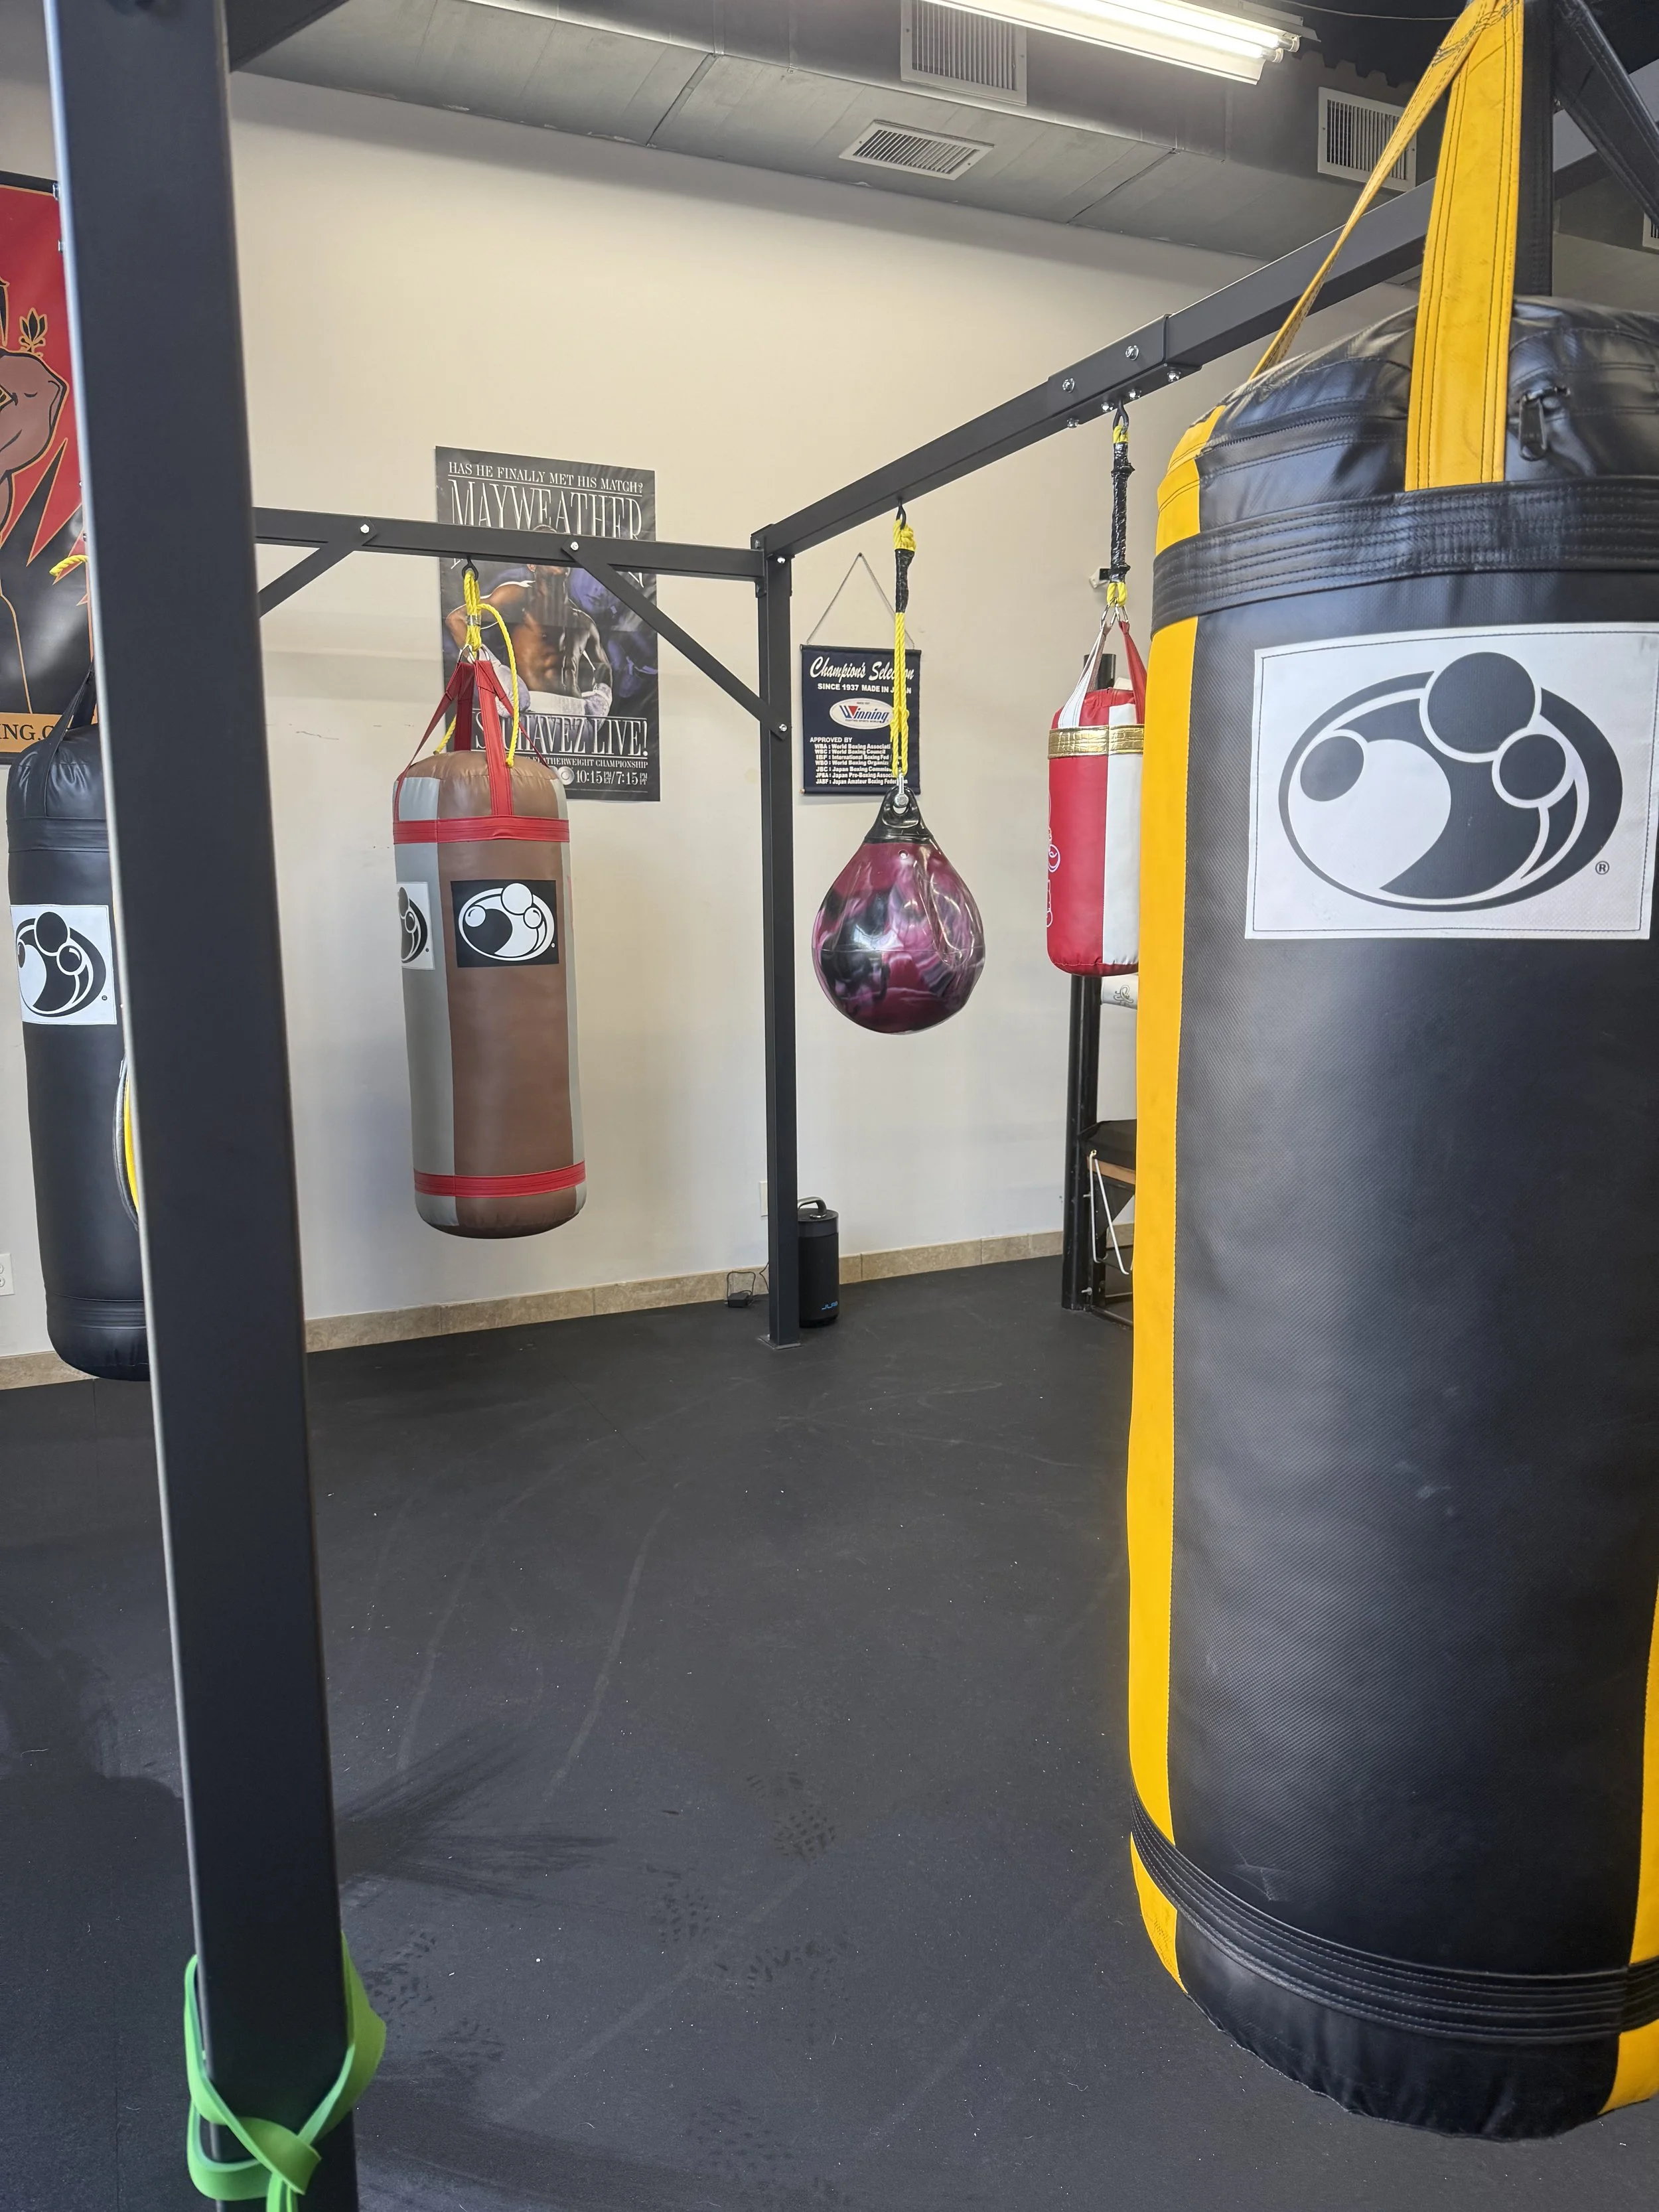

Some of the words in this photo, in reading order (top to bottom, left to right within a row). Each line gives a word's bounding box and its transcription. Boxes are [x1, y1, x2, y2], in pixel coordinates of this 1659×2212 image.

[449, 462, 472, 475] HAS
[476, 464, 493, 477] HE
[497, 467, 545, 482] FINALLY
[549, 472, 574, 485] MET
[578, 475, 597, 488] HIS
[601, 478, 643, 494] MATCH?
[448, 479, 644, 564] MAYWEATHER
[810, 656, 866, 683] Champion's
[869, 661, 914, 681] Selecon
[839, 705, 889, 723] Winning
[592, 718, 648, 756] LIVE!
[576, 769, 603, 785] 10:15
[595, 759, 648, 769] CHAMPIONSHIP
